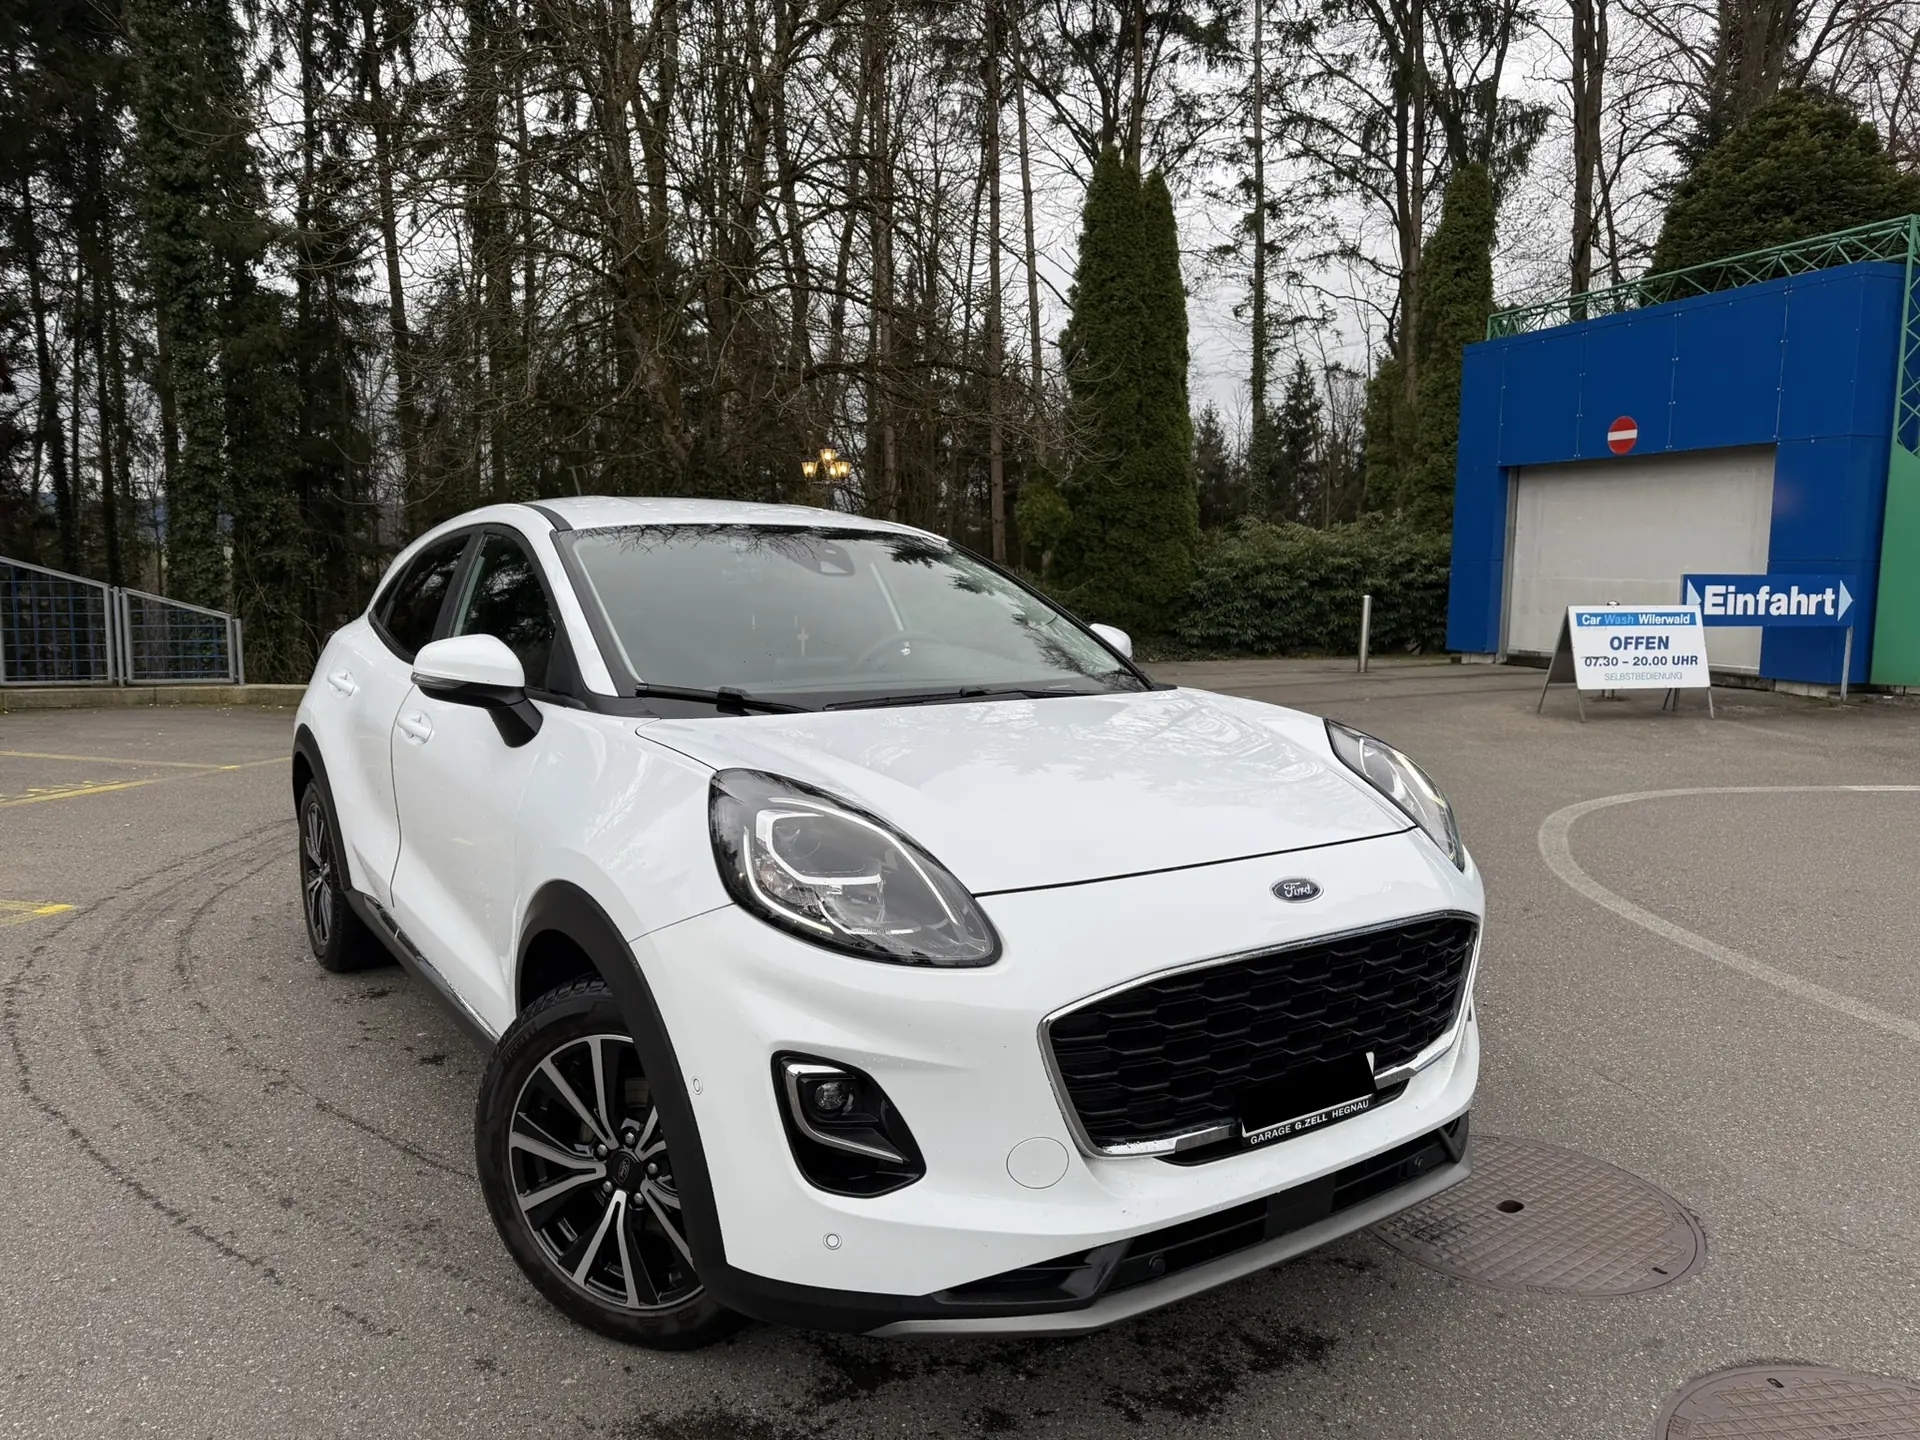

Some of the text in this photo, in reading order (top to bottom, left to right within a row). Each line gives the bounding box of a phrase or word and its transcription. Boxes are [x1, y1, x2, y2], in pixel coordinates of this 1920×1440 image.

[1703, 585, 1836, 616] Einfahrt
[1581, 613, 1691, 625] Car Wash Wilerwald
[1609, 635, 1670, 651] OFFEN
[1584, 656, 1619, 667] 07.30
[1632, 656, 1668, 667] 20.00
[1671, 655, 1699, 666] UHR
[1604, 671, 1683, 681] SELBSTBEDIENUNG
[1283, 882, 1313, 898] Ford
[1250, 1124, 1292, 1145] GARAGE
[1331, 1099, 1370, 1119] HEGNAU
